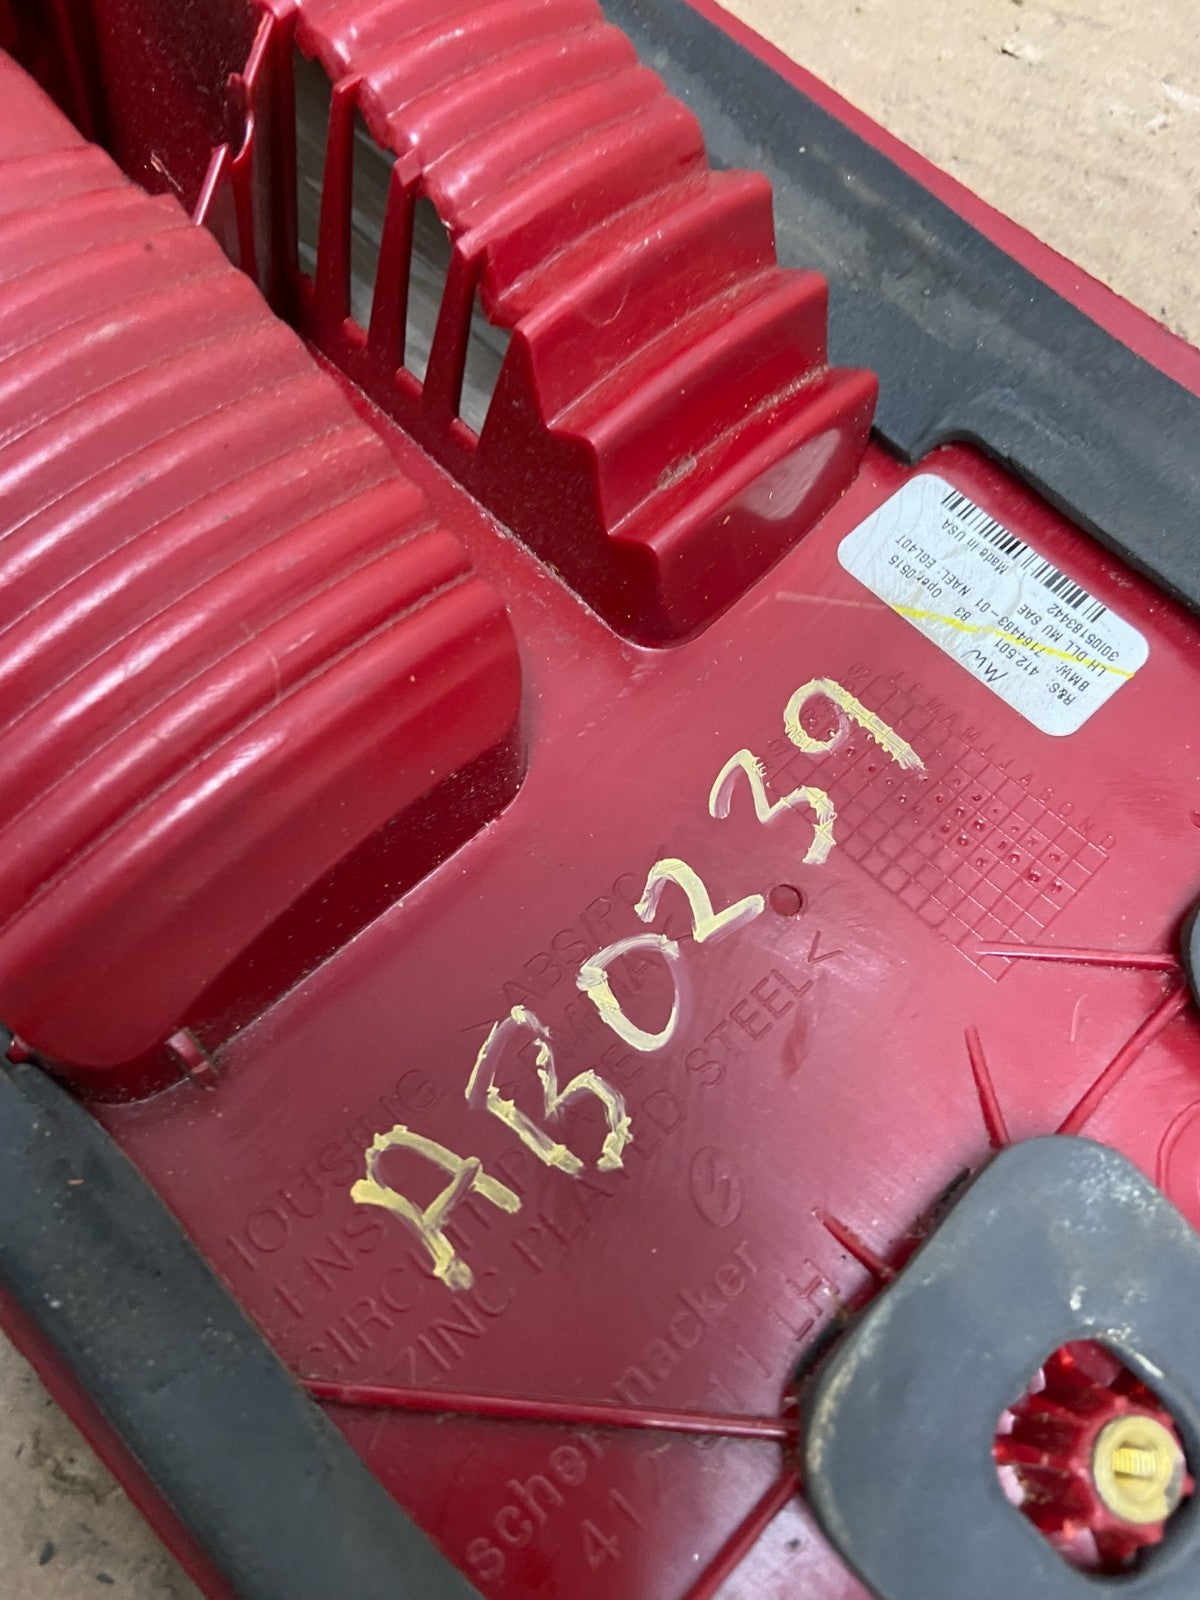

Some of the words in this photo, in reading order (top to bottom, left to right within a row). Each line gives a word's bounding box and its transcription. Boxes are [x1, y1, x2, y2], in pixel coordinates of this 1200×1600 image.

[942, 520, 966, 541] USA
[981, 548, 1010, 576] Made
[938, 567, 971, 596] NAEL:
[954, 606, 972, 622] B3
[1016, 604, 1044, 627] SAE
[1041, 625, 1064, 643] MU
[993, 640, 1040, 677] 412.501
[1065, 640, 1088, 663] DLL
[1055, 664, 1090, 692] BMW:
[1090, 659, 1108, 677] LH
[1046, 683, 1076, 706] R&S:
